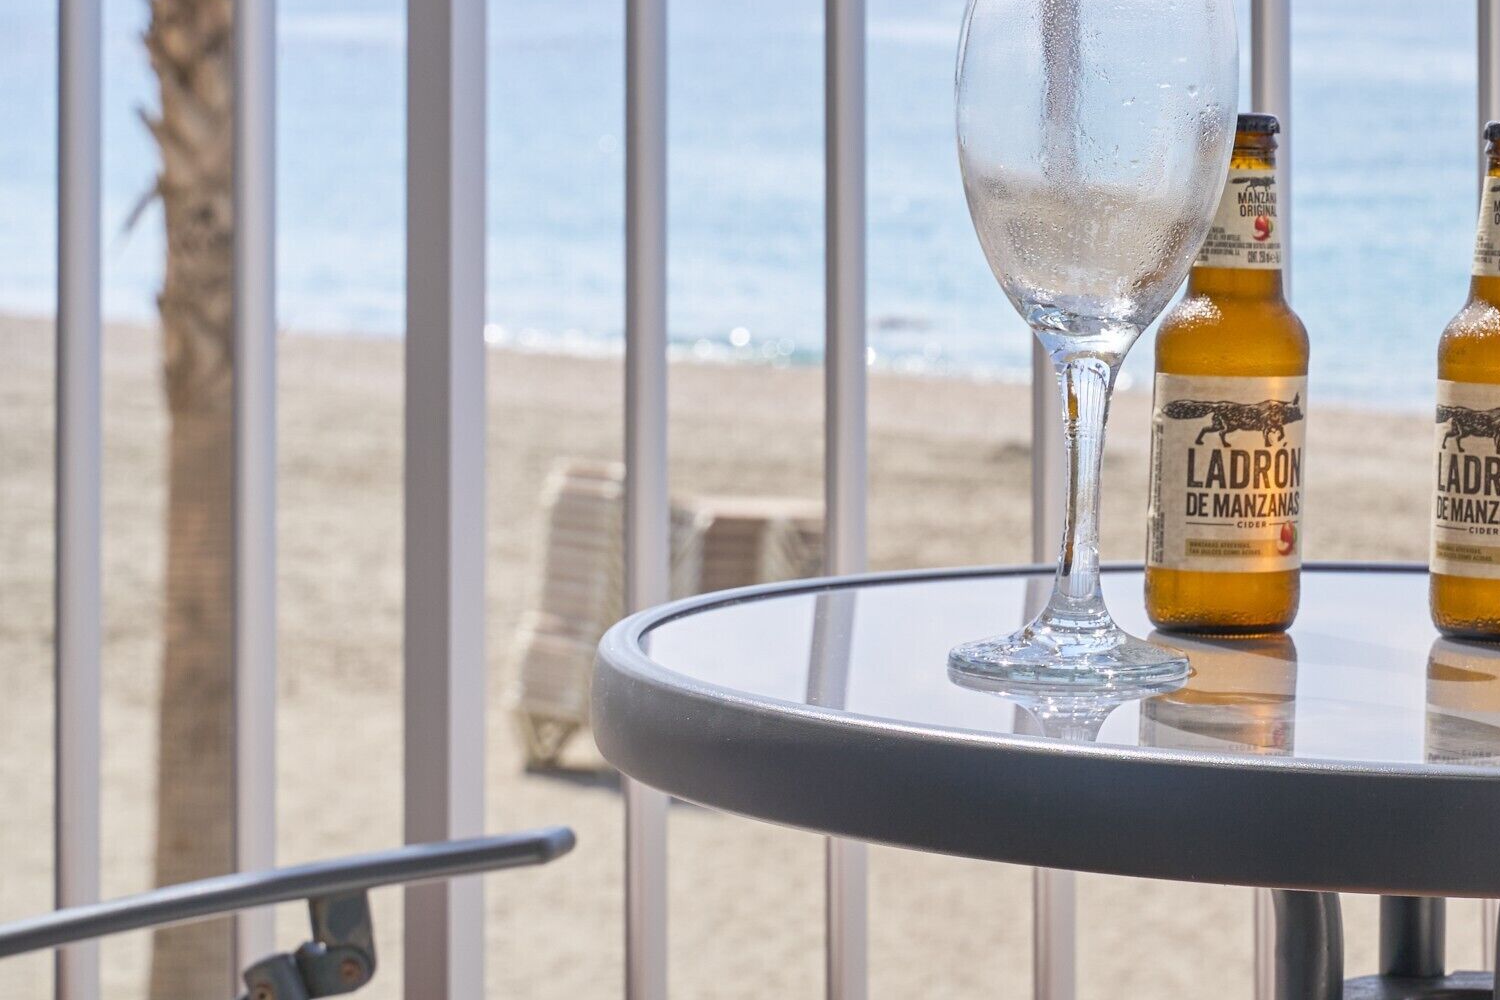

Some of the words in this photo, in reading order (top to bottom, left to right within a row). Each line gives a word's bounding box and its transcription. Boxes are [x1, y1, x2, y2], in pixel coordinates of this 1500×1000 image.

[1186, 442, 1301, 490] LADRÓN
[1185, 493, 1208, 517] DE
[1213, 491, 1300, 518] MANZANAS
[1436, 495, 1449, 520] DE
[1236, 521, 1267, 529] CIDER
[1468, 526, 1499, 536] CIDER
